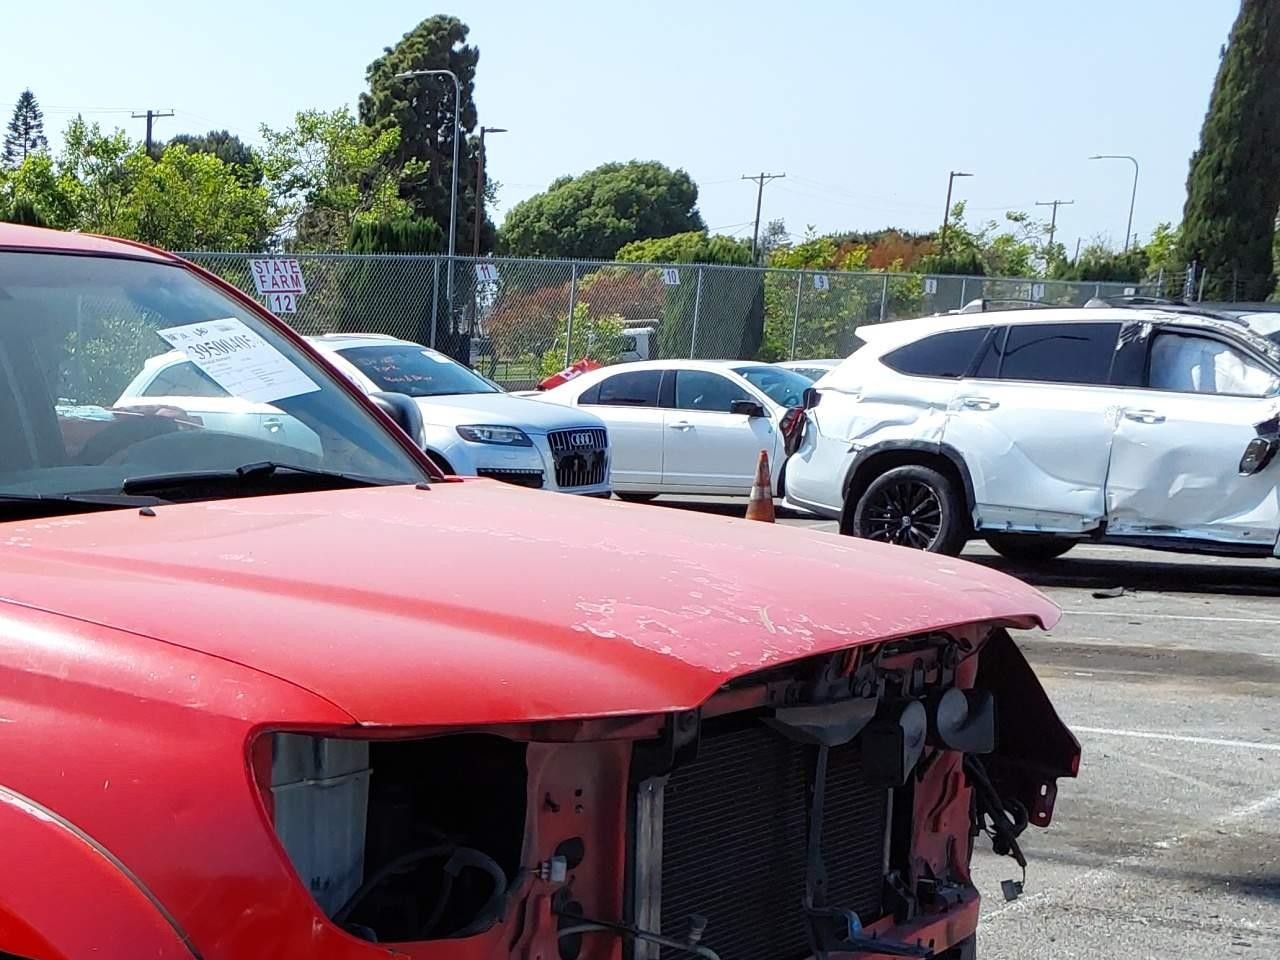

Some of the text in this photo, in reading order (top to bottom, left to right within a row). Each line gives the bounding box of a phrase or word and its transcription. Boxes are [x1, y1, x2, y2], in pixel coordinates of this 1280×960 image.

[254, 260, 300, 274] STATE
[480, 264, 491, 279] 11
[259, 274, 301, 289] FARM
[667, 270, 677, 283] 10
[275, 295, 293, 311] 12
